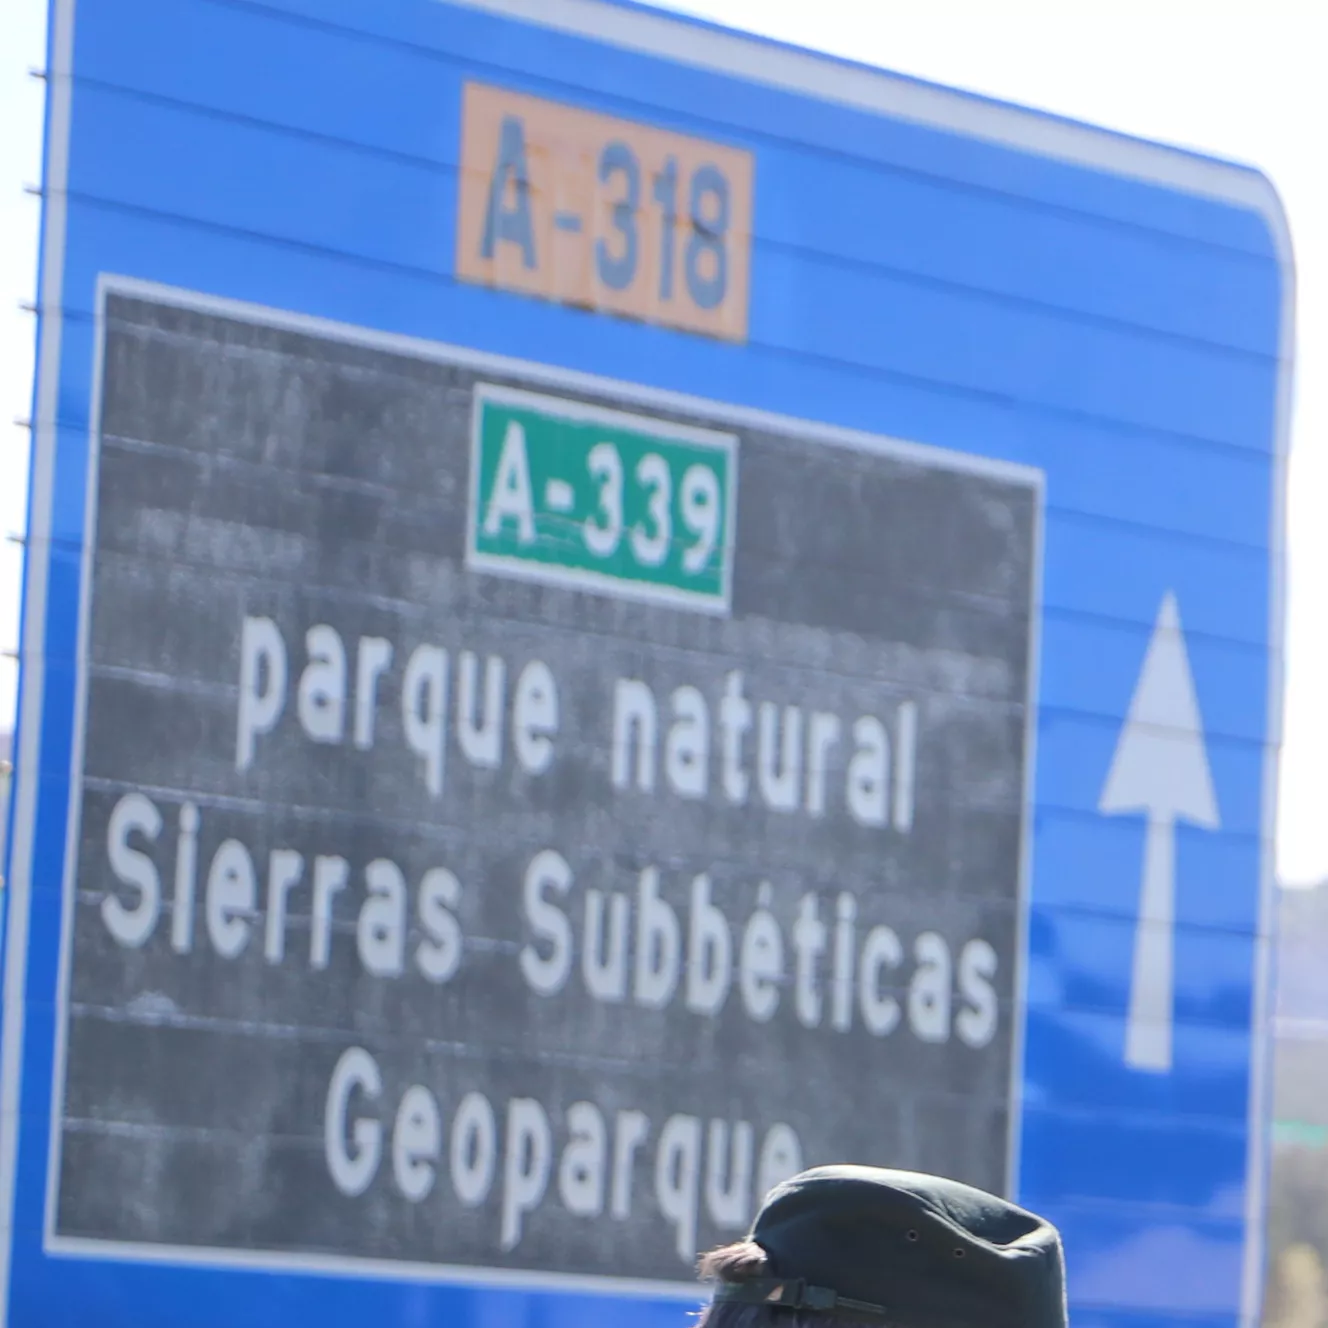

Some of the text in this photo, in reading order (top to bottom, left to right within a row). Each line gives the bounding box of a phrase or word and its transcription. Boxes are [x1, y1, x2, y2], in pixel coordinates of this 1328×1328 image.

[480, 112, 732, 312] A-318
[482, 420, 722, 577] A-339
[236, 615, 917, 835] parque natural
[101, 793, 999, 1050] Sierras Subbéticas
[325, 1045, 802, 1264] Geoparque
